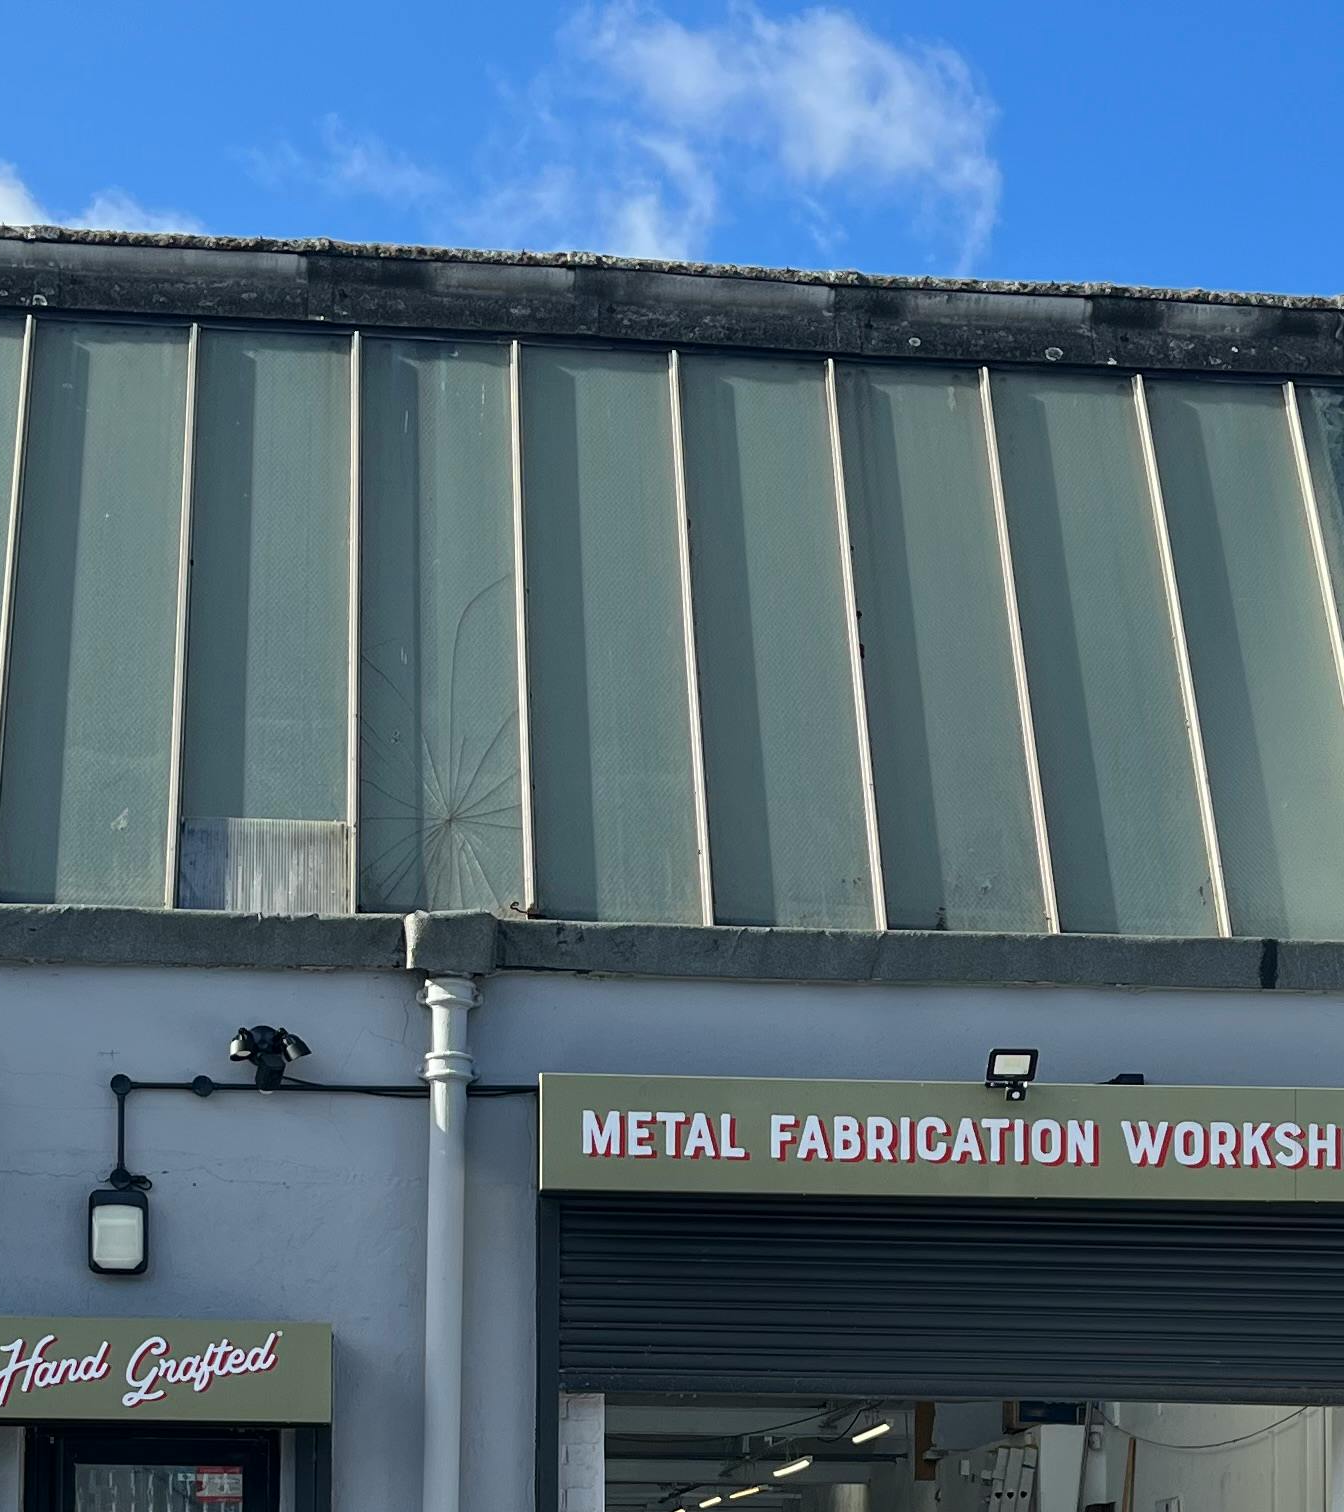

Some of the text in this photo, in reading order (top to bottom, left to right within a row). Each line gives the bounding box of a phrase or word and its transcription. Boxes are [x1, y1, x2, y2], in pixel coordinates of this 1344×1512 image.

[582, 1109, 750, 1161] METAL
[770, 1113, 1100, 1167] FABRICATION
[122, 1331, 279, 1407] Grafted
